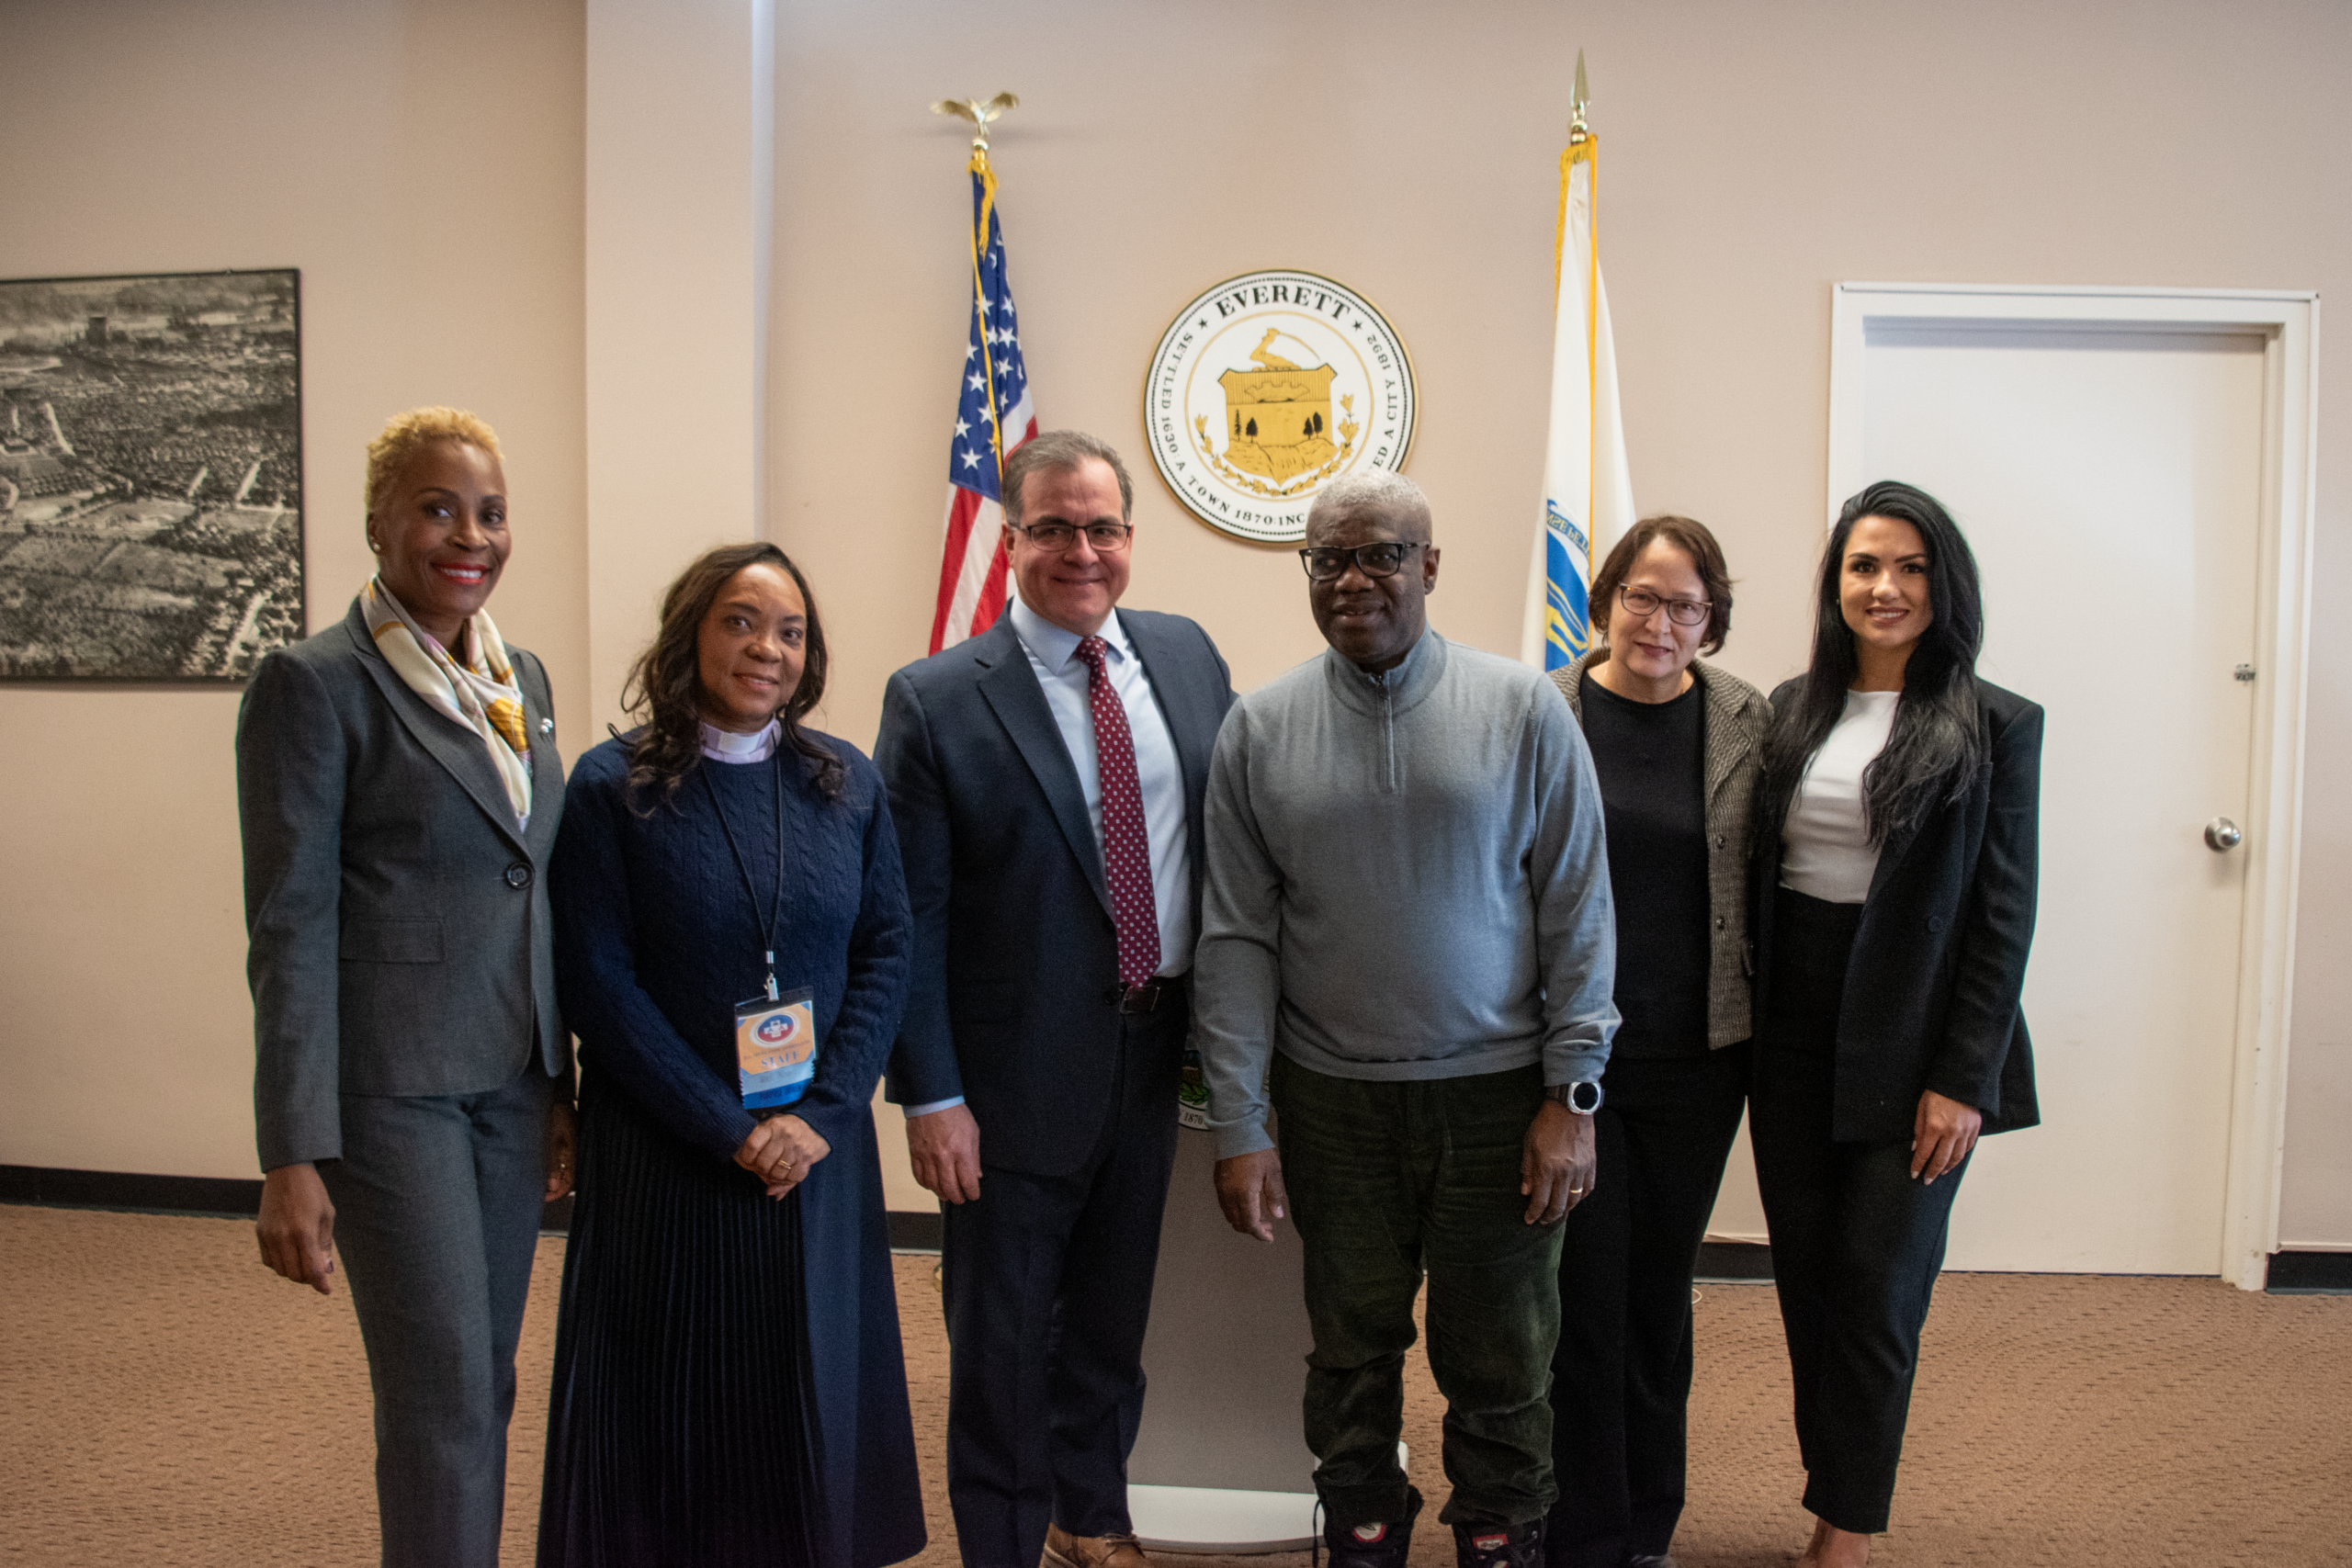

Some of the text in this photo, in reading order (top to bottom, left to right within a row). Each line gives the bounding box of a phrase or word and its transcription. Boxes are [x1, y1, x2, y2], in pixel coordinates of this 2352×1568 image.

[1216, 284, 1351, 320] EVERETT
[1367, 333, 1392, 370] 1892
[1161, 332, 1193, 410] SETTLED
[1385, 378, 1397, 421] CITY
[1385, 428, 1395, 439] A
[1369, 446, 1388, 469] ED
[1188, 475, 1230, 513] TOWN
[1183, 1111, 1204, 1125] 1870
